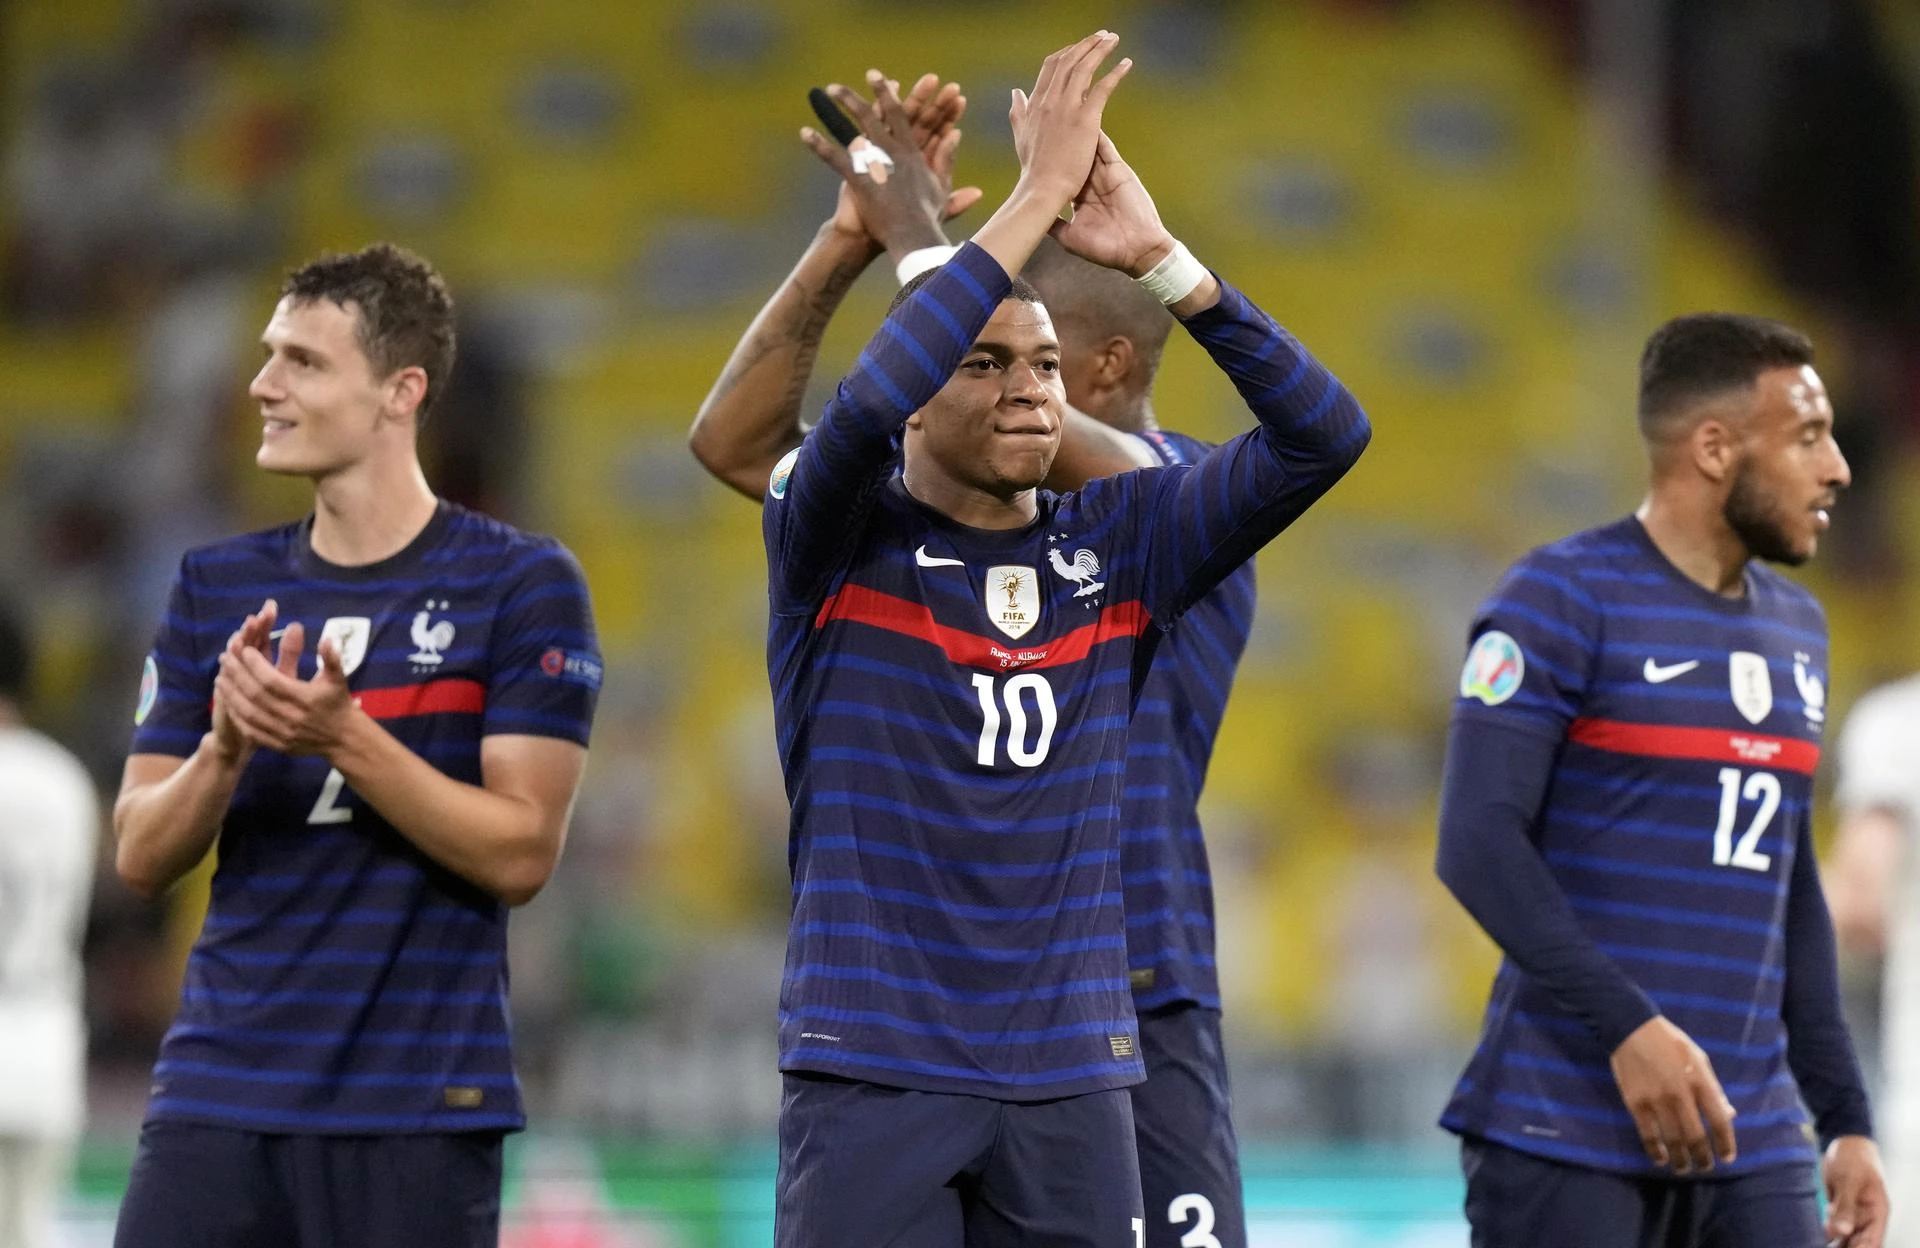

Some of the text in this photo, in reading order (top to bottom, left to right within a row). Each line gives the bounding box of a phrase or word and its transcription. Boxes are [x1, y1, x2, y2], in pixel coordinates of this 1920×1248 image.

[1003, 612, 1025, 620] FIFA
[1000, 659, 1008, 668] 15
[972, 673, 1057, 767] 10
[305, 767, 353, 825] 2
[1712, 767, 1782, 872] 12
[1167, 1192, 1223, 1248] 3
